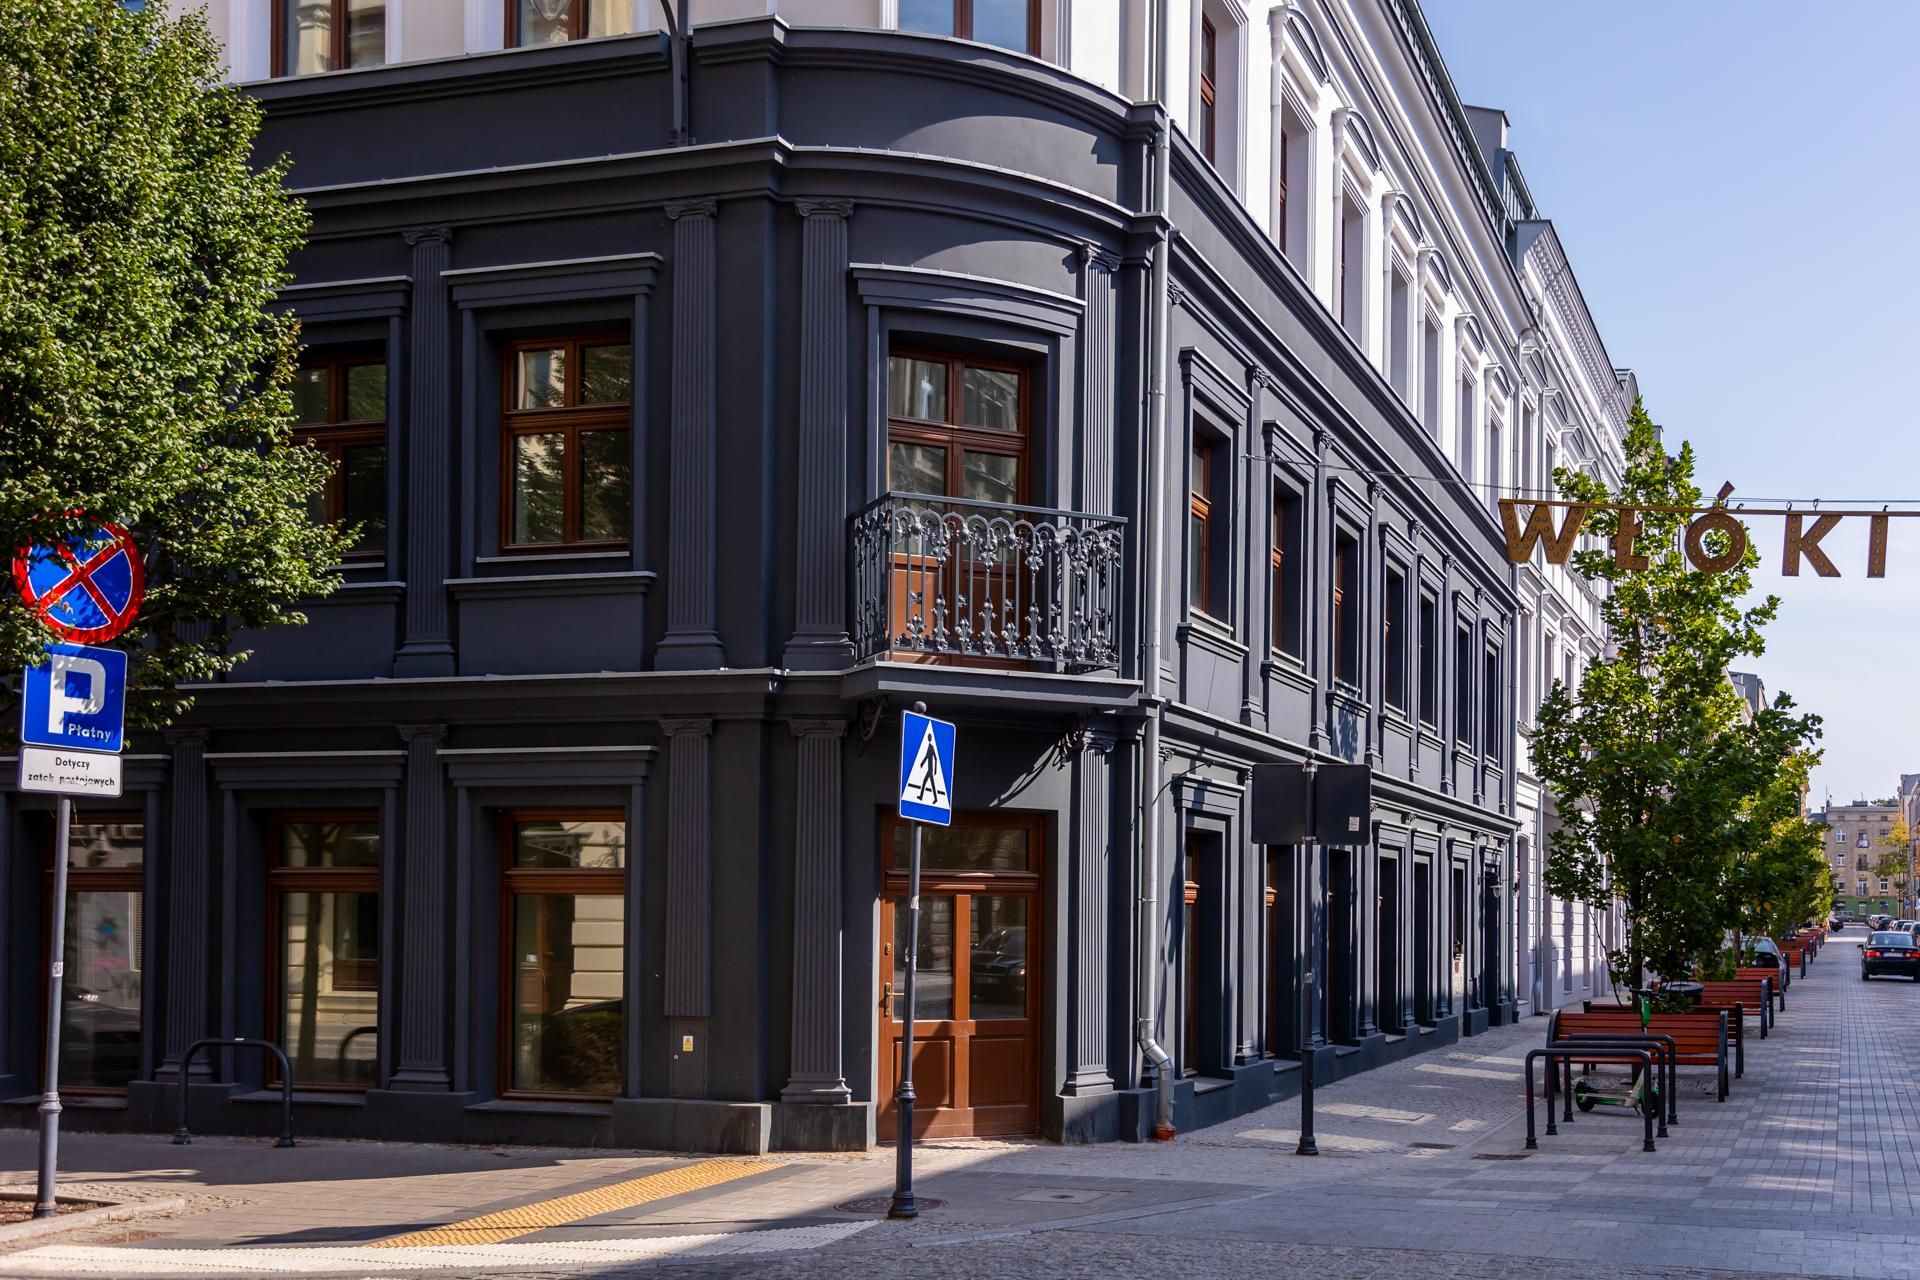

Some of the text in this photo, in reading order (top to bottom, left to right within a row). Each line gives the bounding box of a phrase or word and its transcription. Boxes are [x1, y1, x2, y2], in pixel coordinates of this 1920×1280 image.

[47, 653, 107, 735] P
[67, 722, 112, 743] Płatny
[55, 756, 91, 770] Dotyczy
